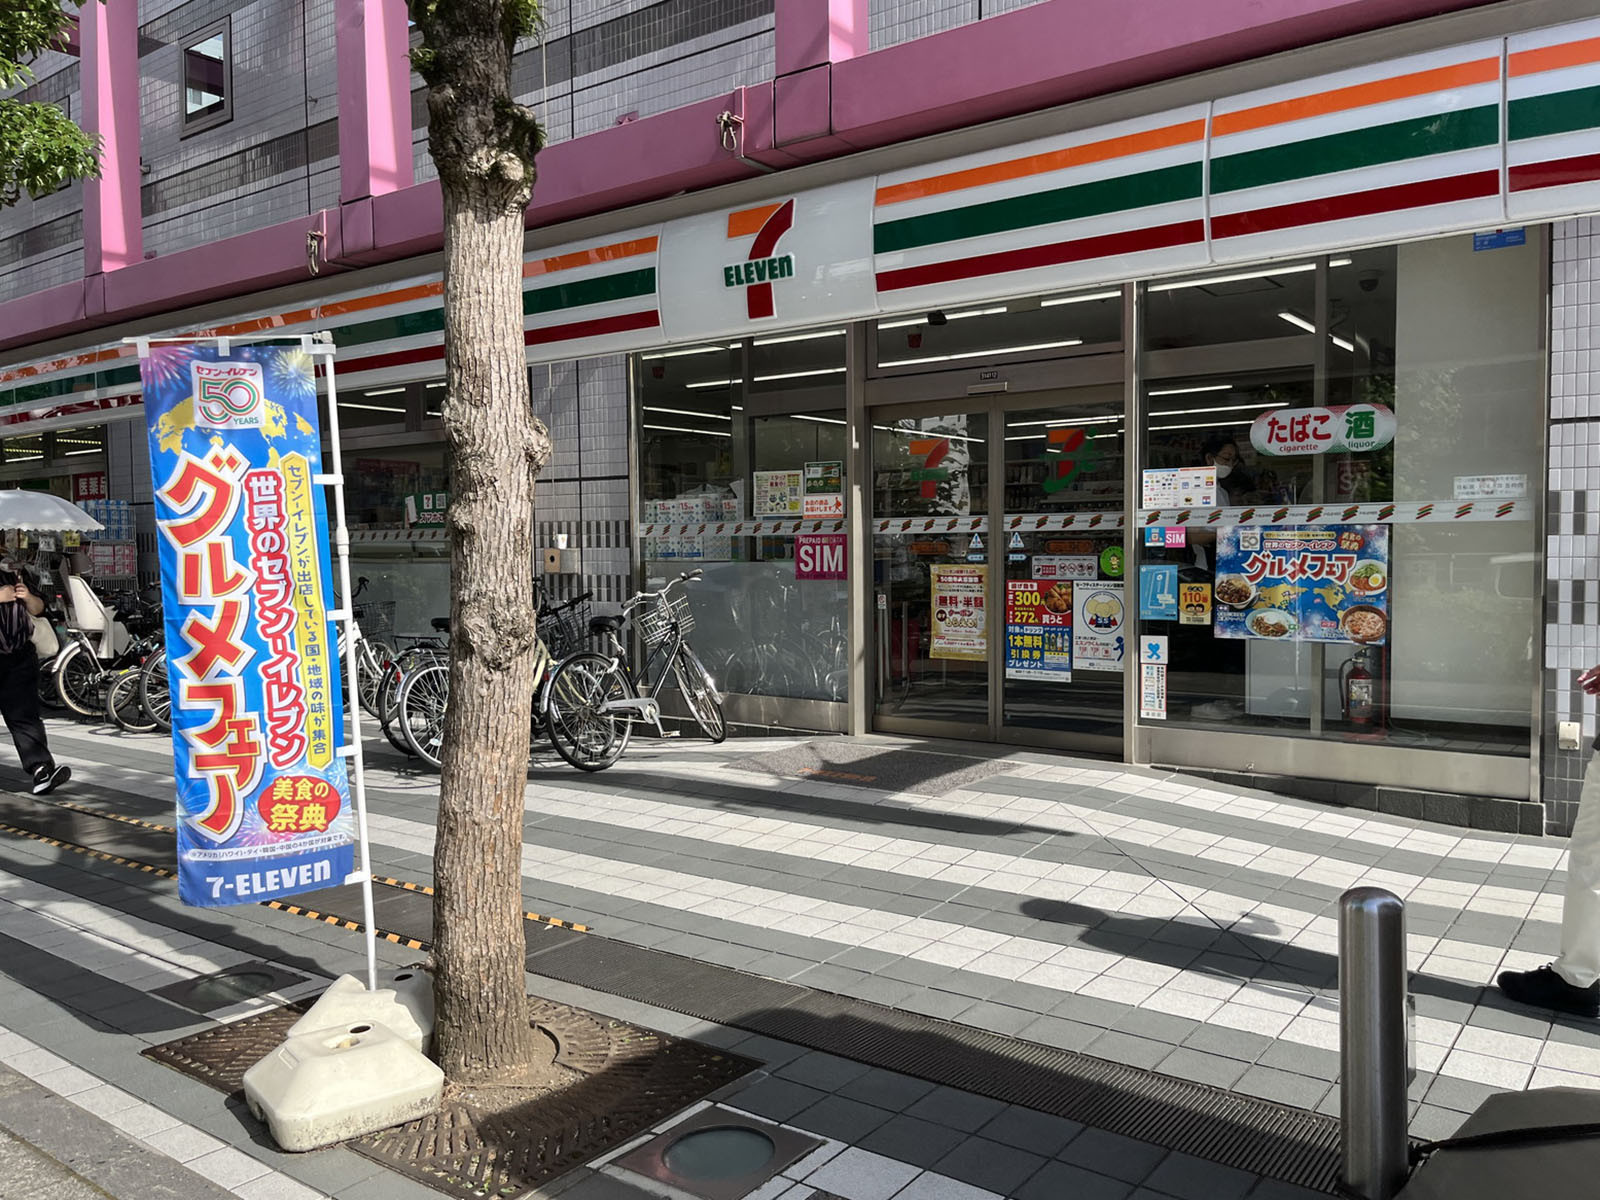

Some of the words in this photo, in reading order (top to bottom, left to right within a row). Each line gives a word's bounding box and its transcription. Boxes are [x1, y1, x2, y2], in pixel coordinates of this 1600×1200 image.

[199, 377, 260, 424] 50
[233, 415, 259, 426] YEARS
[1267, 413, 1331, 443] たばこ
[1345, 410, 1375, 439] 酒
[1279, 443, 1319, 453] cigarette
[1348, 440, 1376, 450] liquor
[1166, 533, 1185, 544] SIM
[799, 545, 843, 572] SIM
[1245, 552, 1356, 583] グルメフェア
[165, 453, 261, 835] グルメフェア
[272, 777, 330, 801] 美食の
[269, 803, 328, 832] 祭典
